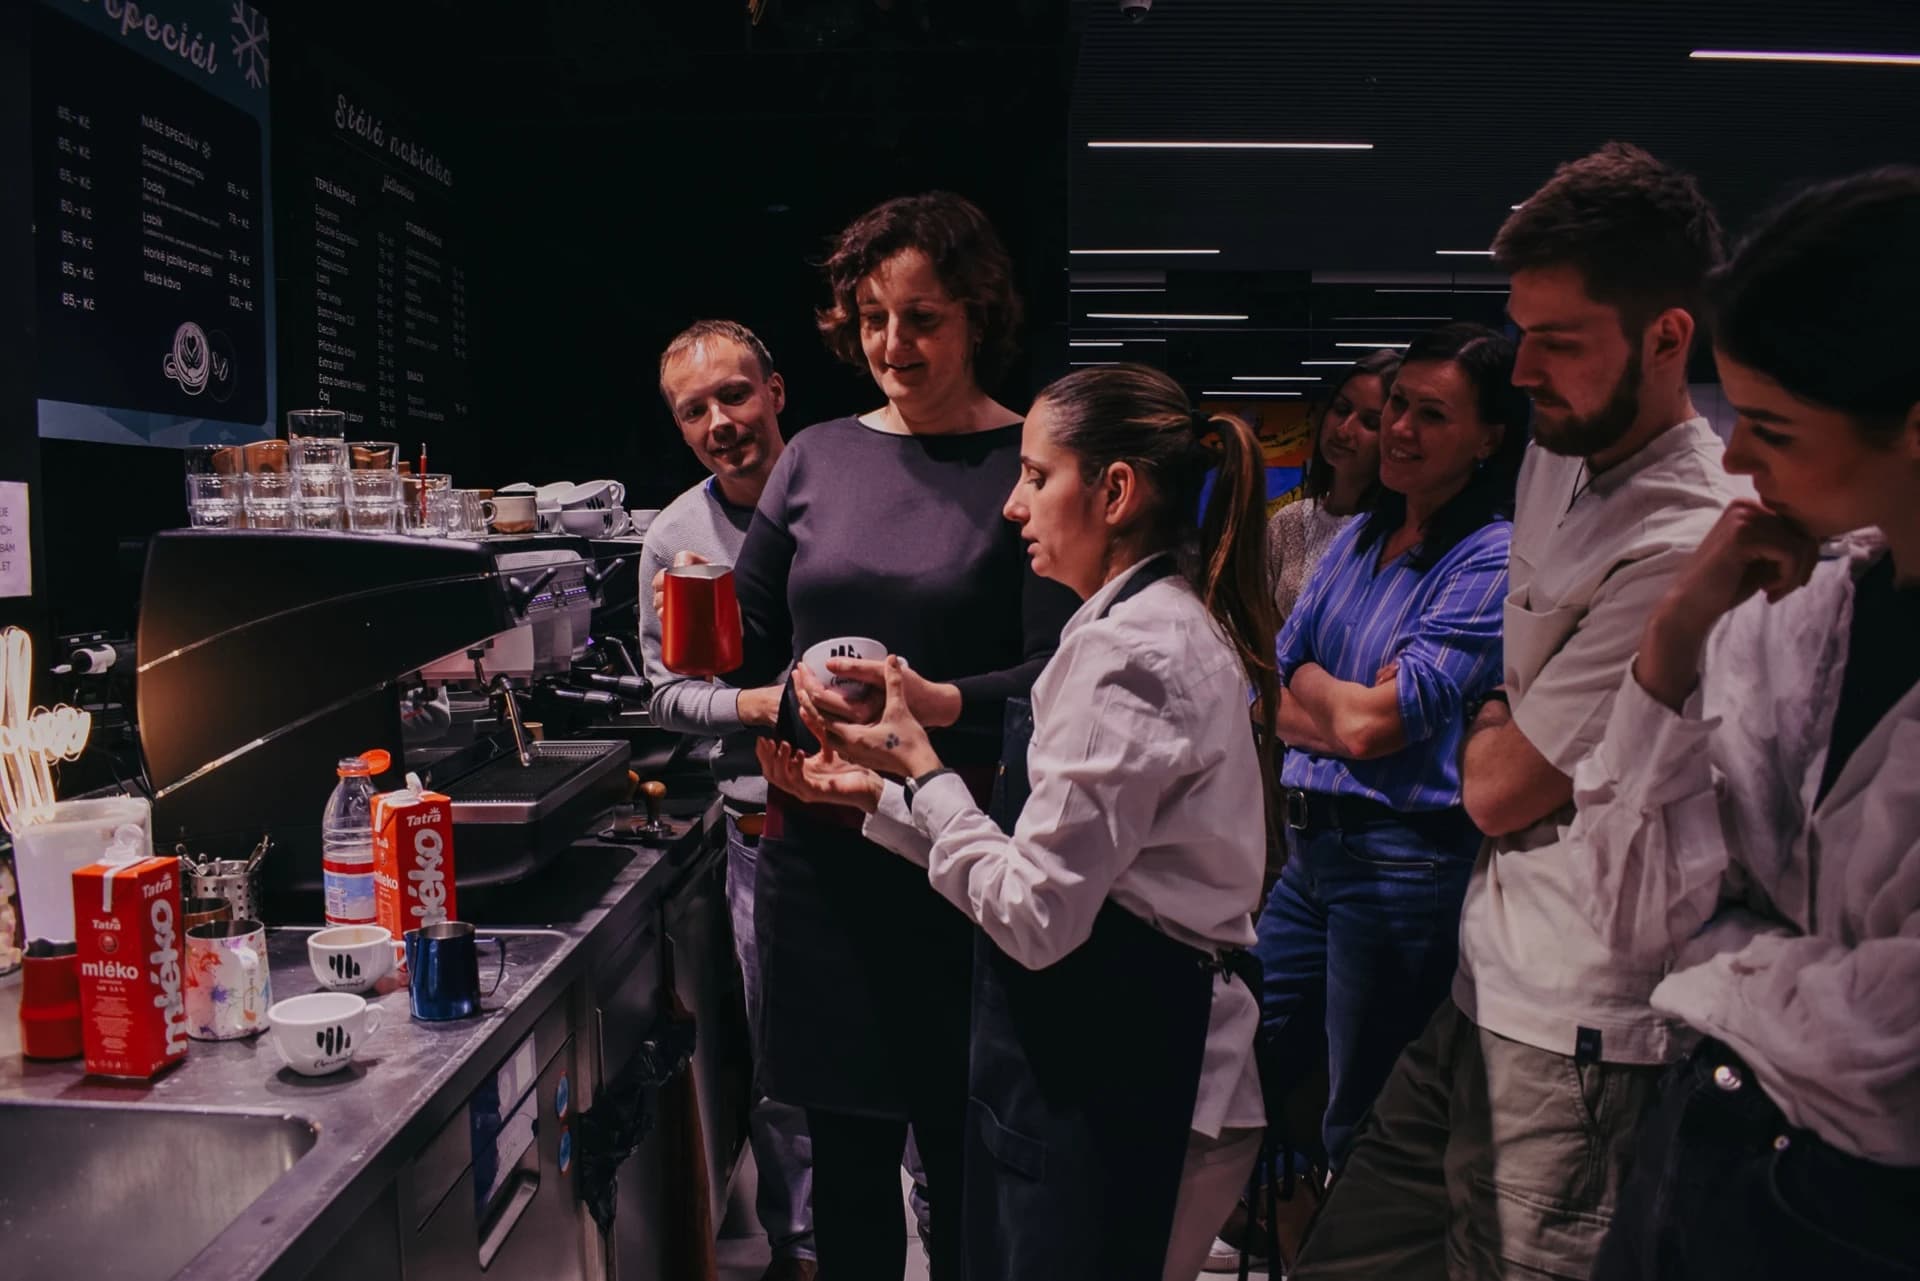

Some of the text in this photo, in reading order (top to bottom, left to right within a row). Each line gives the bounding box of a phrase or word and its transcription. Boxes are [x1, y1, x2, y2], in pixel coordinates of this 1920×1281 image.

[336, 93, 384, 147] Stálá
[82, 236, 94, 251] Kč
[83, 266, 95, 281] Kč
[62, 293, 95, 312] 85,- Kč
[406, 810, 442, 828] Tatra
[142, 875, 173, 899] Tatra
[92, 918, 121, 931] Tatra
[82, 960, 139, 980] mléko
[149, 899, 187, 1057] mléko
